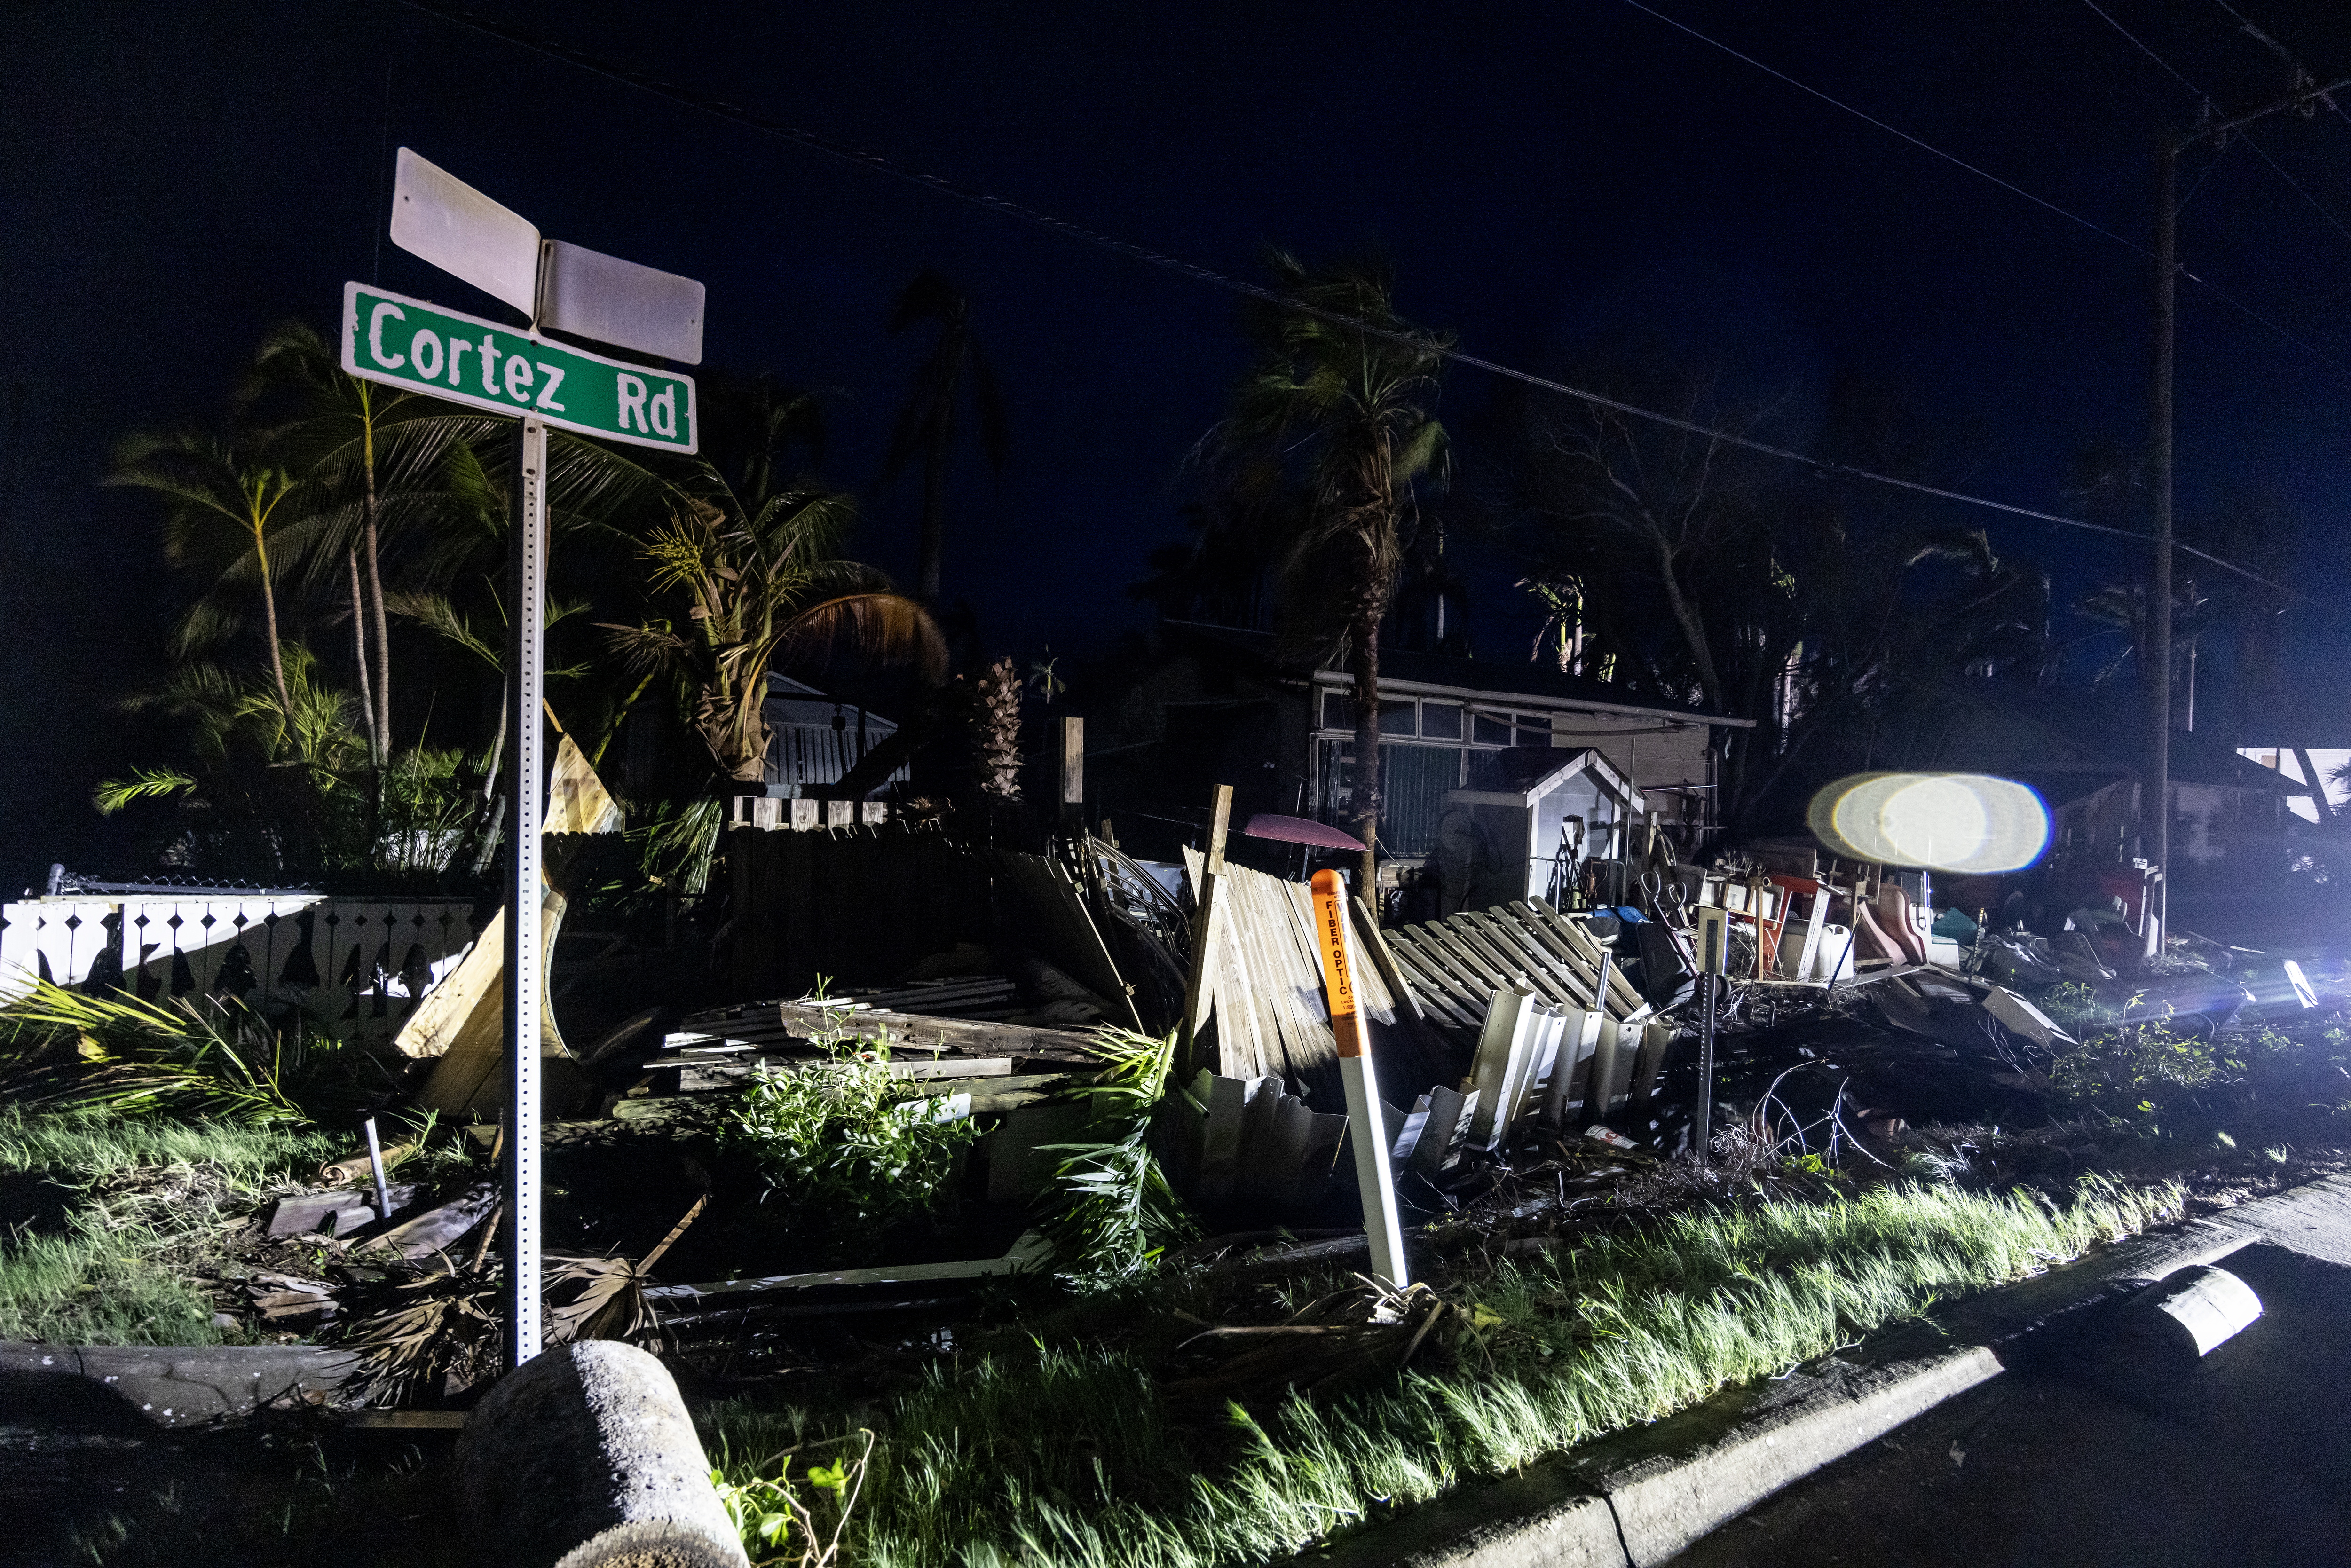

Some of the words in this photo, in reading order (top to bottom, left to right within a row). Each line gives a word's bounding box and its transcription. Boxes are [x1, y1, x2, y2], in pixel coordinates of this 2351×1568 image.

[369, 303, 565, 412] Cortez
[617, 372, 677, 439] Rd
[1326, 901, 1339, 946] FIBER
[1333, 950, 1348, 995] OPTIC
